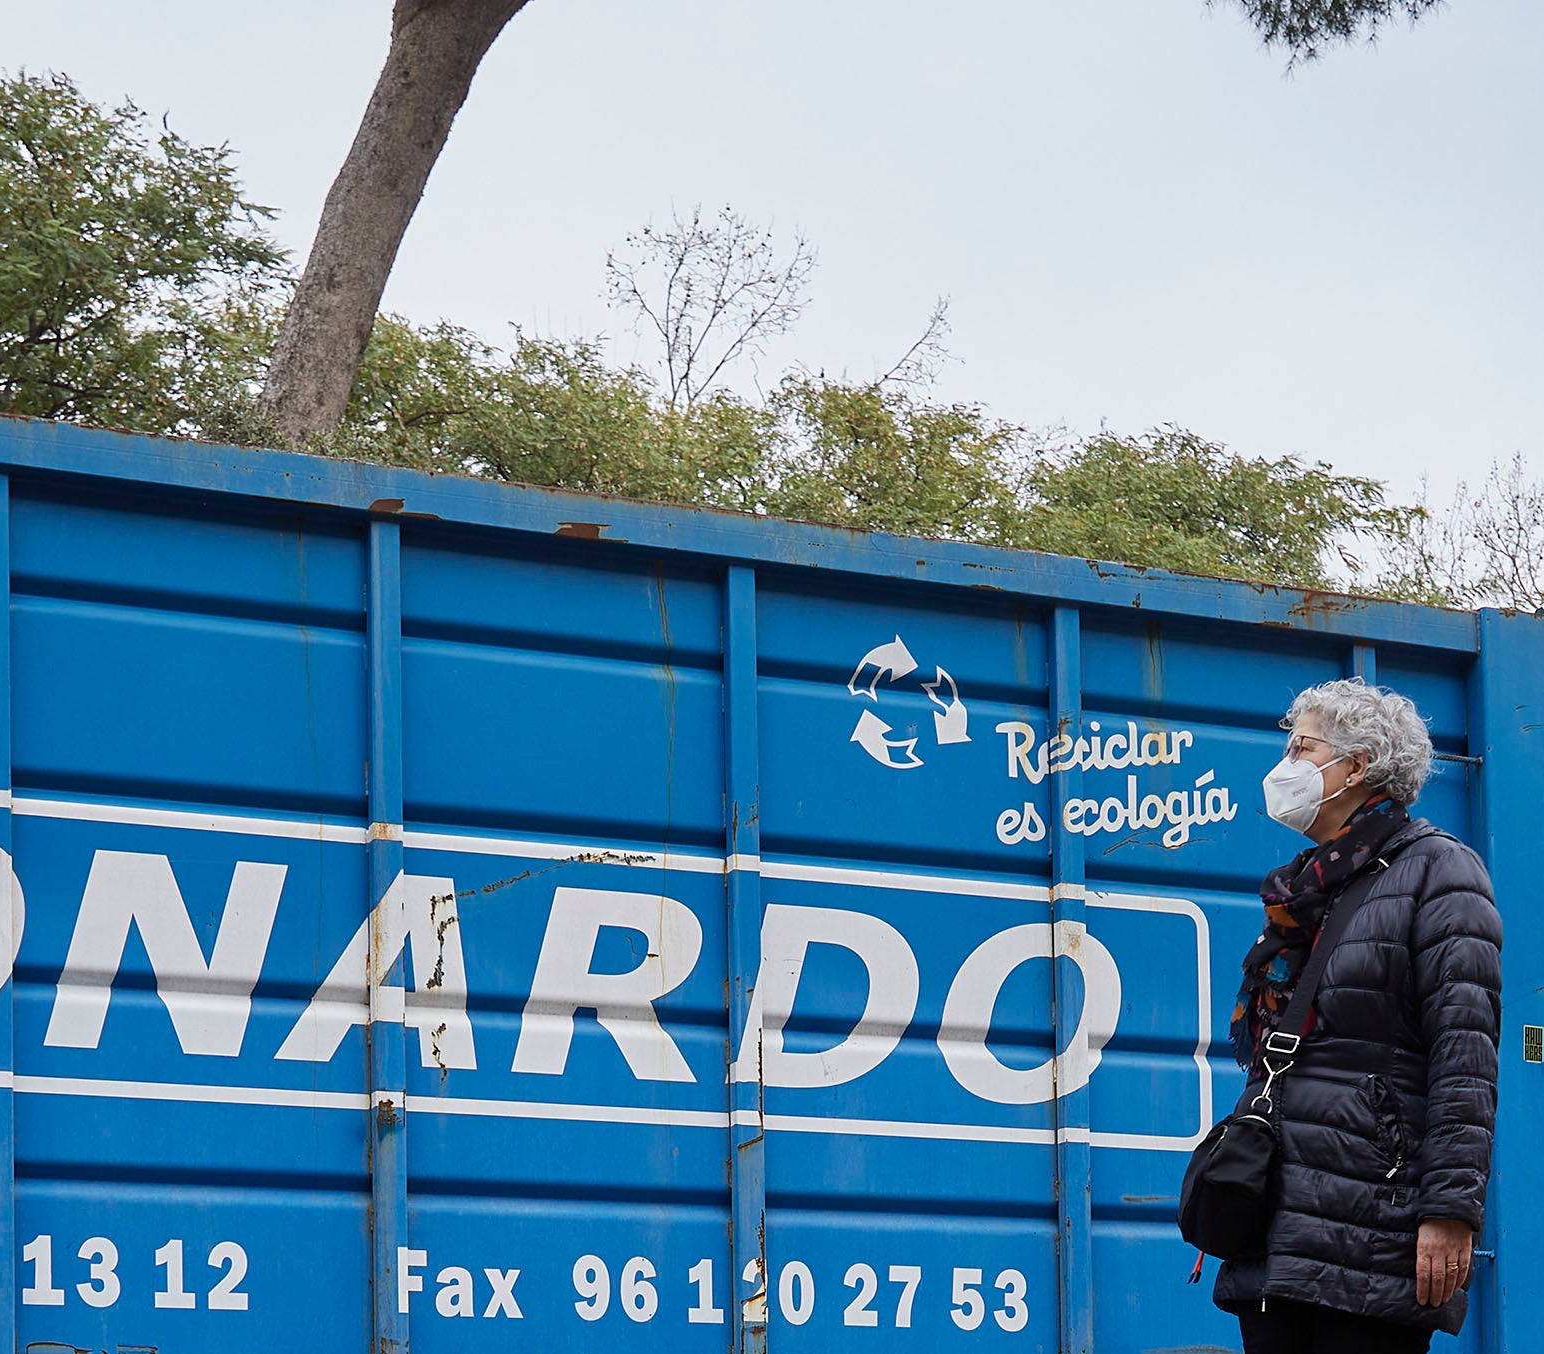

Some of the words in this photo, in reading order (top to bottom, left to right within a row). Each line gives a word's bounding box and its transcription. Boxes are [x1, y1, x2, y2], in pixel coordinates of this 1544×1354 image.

[996, 721, 1193, 785] Reciclar
[996, 801, 1047, 846] es
[1063, 769, 1239, 849] ecología
[23, 1235, 122, 1309] 13
[155, 1239, 250, 1311] 12
[397, 1247, 525, 1320] Fax
[573, 1255, 660, 1324] 96
[689, 1258, 816, 1327] 120
[844, 1263, 923, 1329] 27
[951, 1268, 1030, 1334] 53
